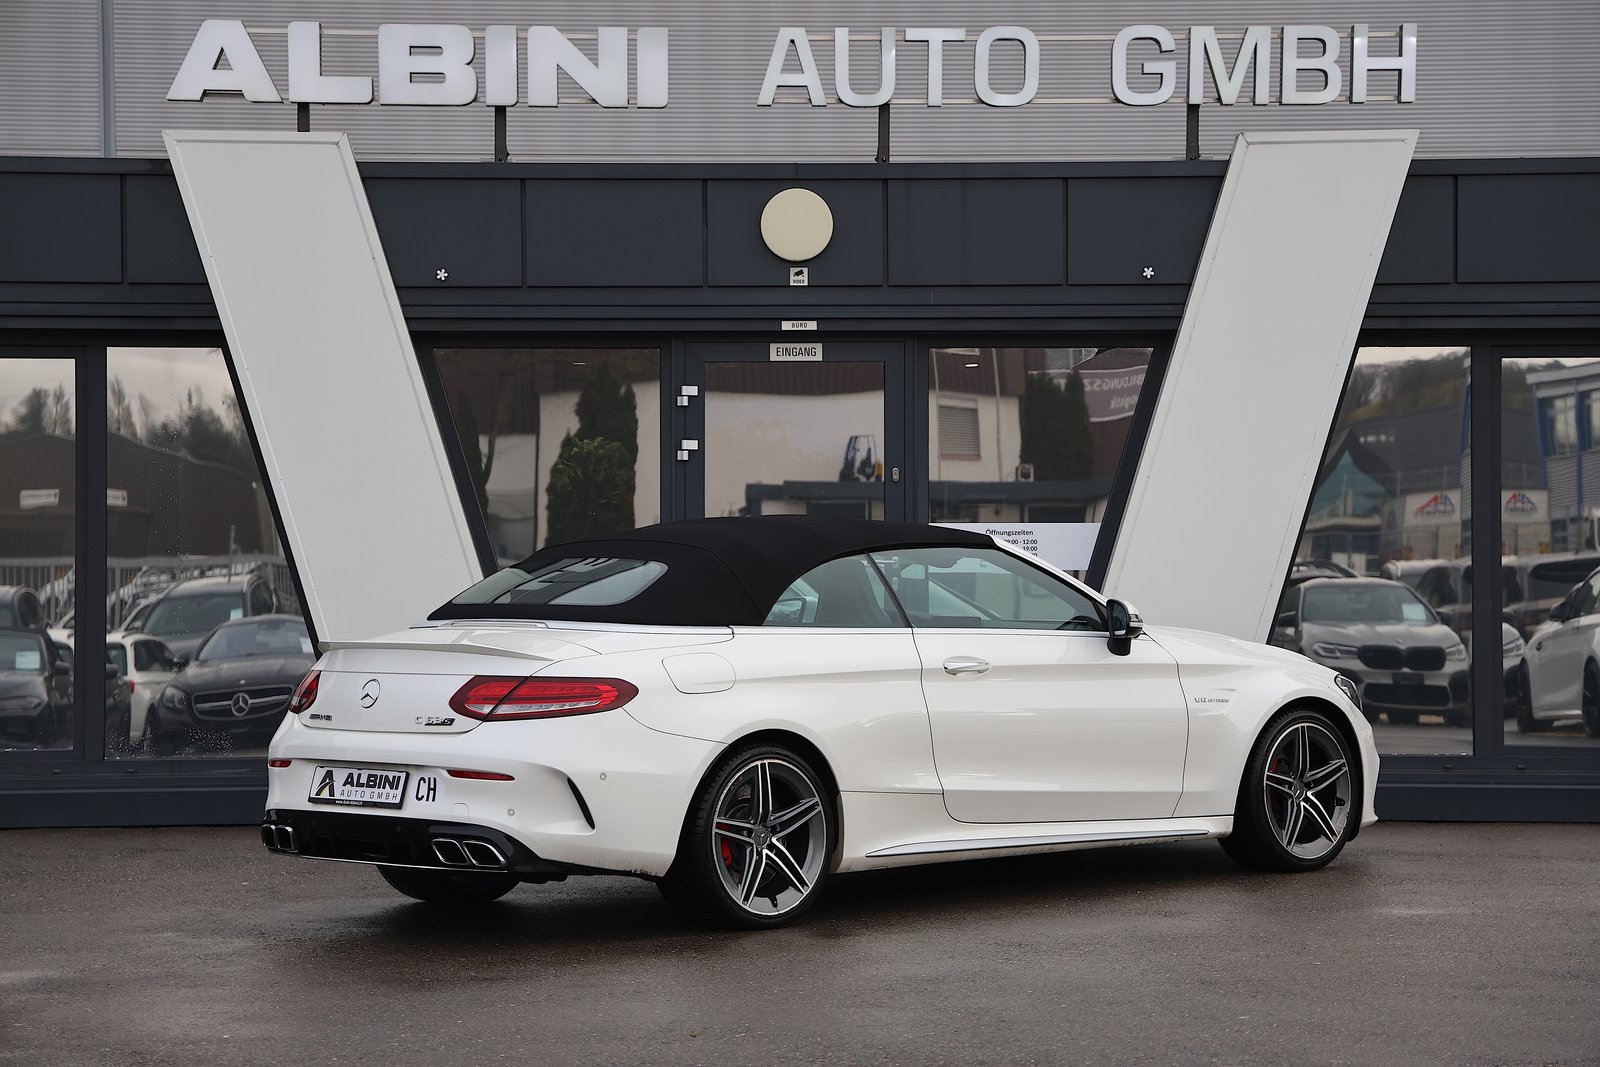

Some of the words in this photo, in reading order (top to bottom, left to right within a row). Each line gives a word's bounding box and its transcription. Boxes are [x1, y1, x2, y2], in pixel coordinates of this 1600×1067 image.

[165, 19, 669, 108] ALBINI
[756, 25, 1040, 107] AUTO
[1110, 23, 1418, 107] GMBH
[776, 346, 817, 357] EINGANG
[342, 772, 401, 790] ALBINI
[415, 776, 437, 803] CH
[339, 789, 365, 799] AUTO
[369, 791, 398, 801] GMBH
